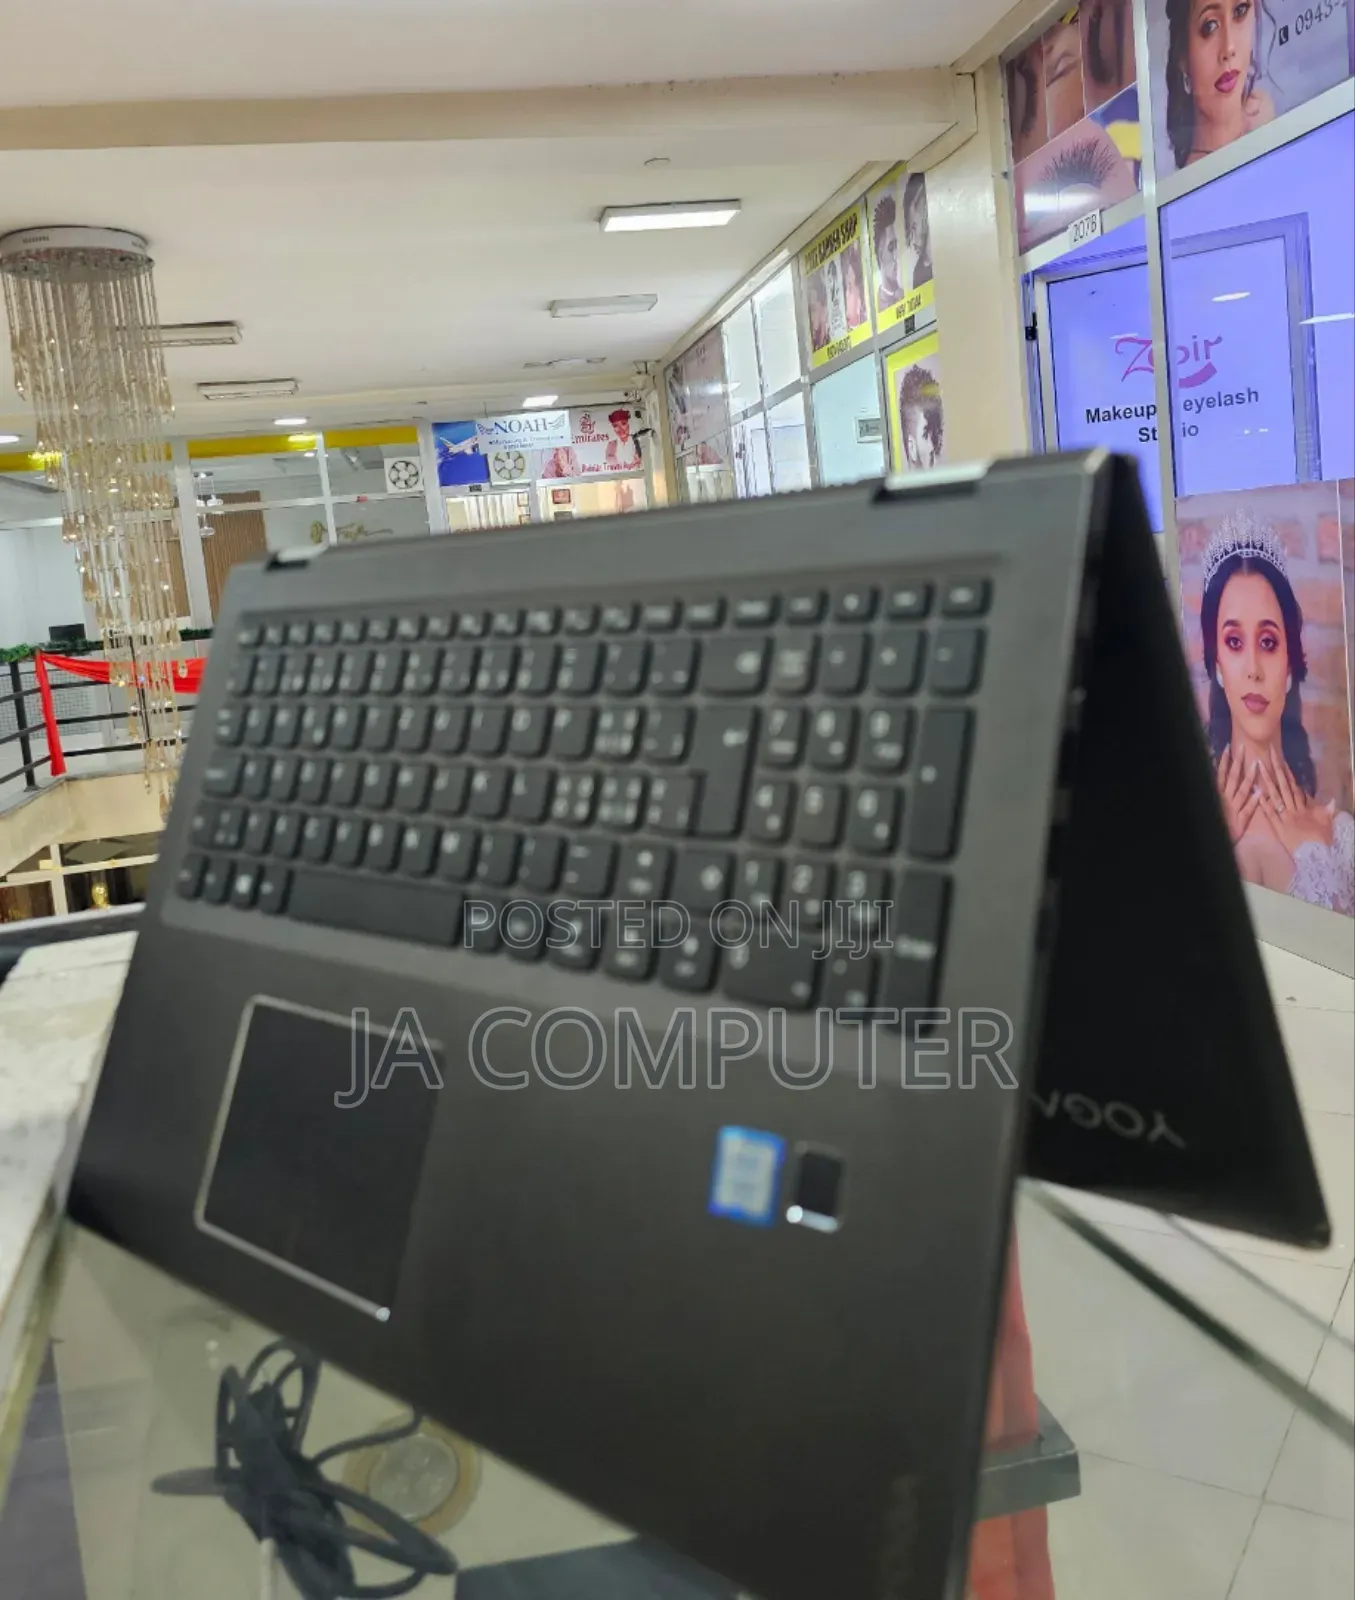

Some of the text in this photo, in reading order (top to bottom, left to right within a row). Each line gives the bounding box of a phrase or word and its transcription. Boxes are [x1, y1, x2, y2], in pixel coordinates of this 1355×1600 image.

[1295, 0, 1346, 35] 0943-
[1086, 387, 1259, 424] Makeup eyelash
[494, 418, 548, 435] NOAH
[1138, 422, 1199, 443] Stio
